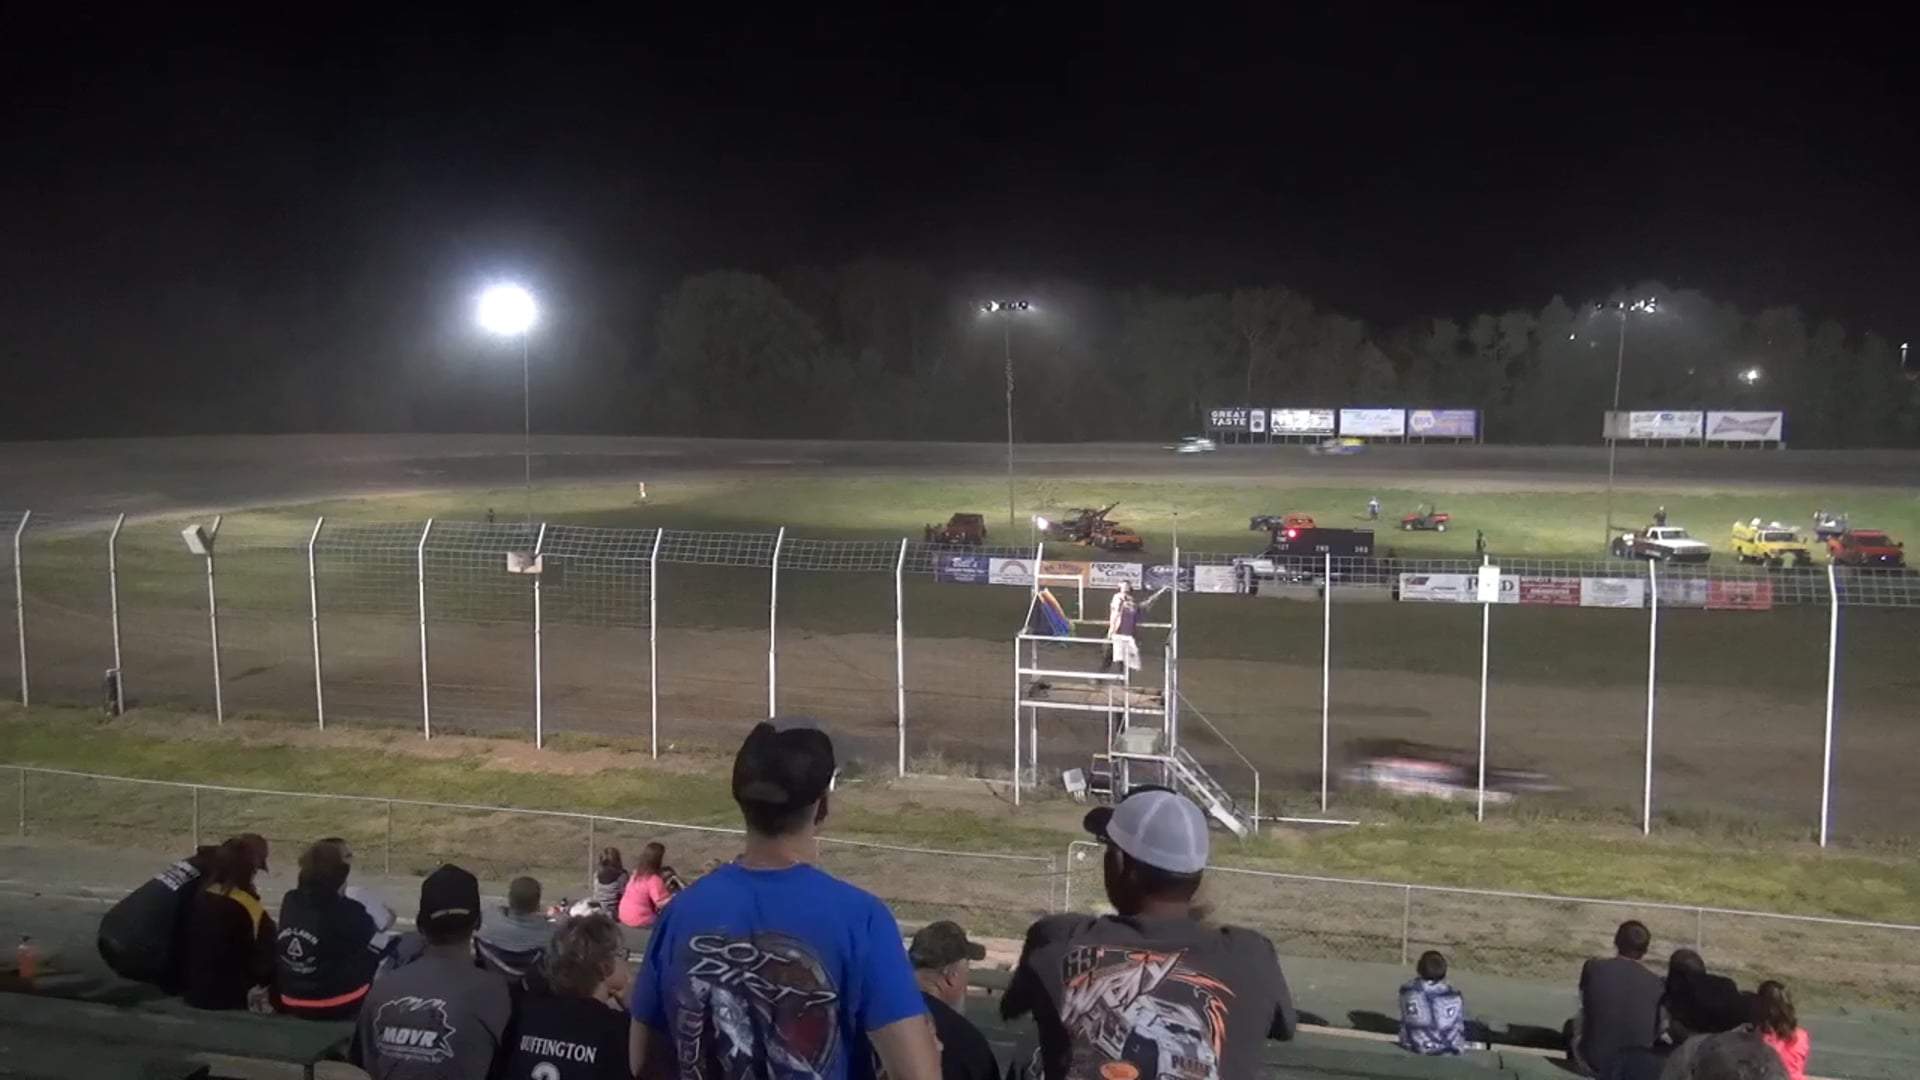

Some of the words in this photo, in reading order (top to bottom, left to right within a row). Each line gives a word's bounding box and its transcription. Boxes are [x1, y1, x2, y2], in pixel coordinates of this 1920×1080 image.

[1211, 410, 1246, 418] GREAT
[1211, 418, 1246, 426] TASTE
[688, 934, 790, 972] GOT
[520, 1035, 597, 1064] BUFFINGTON
